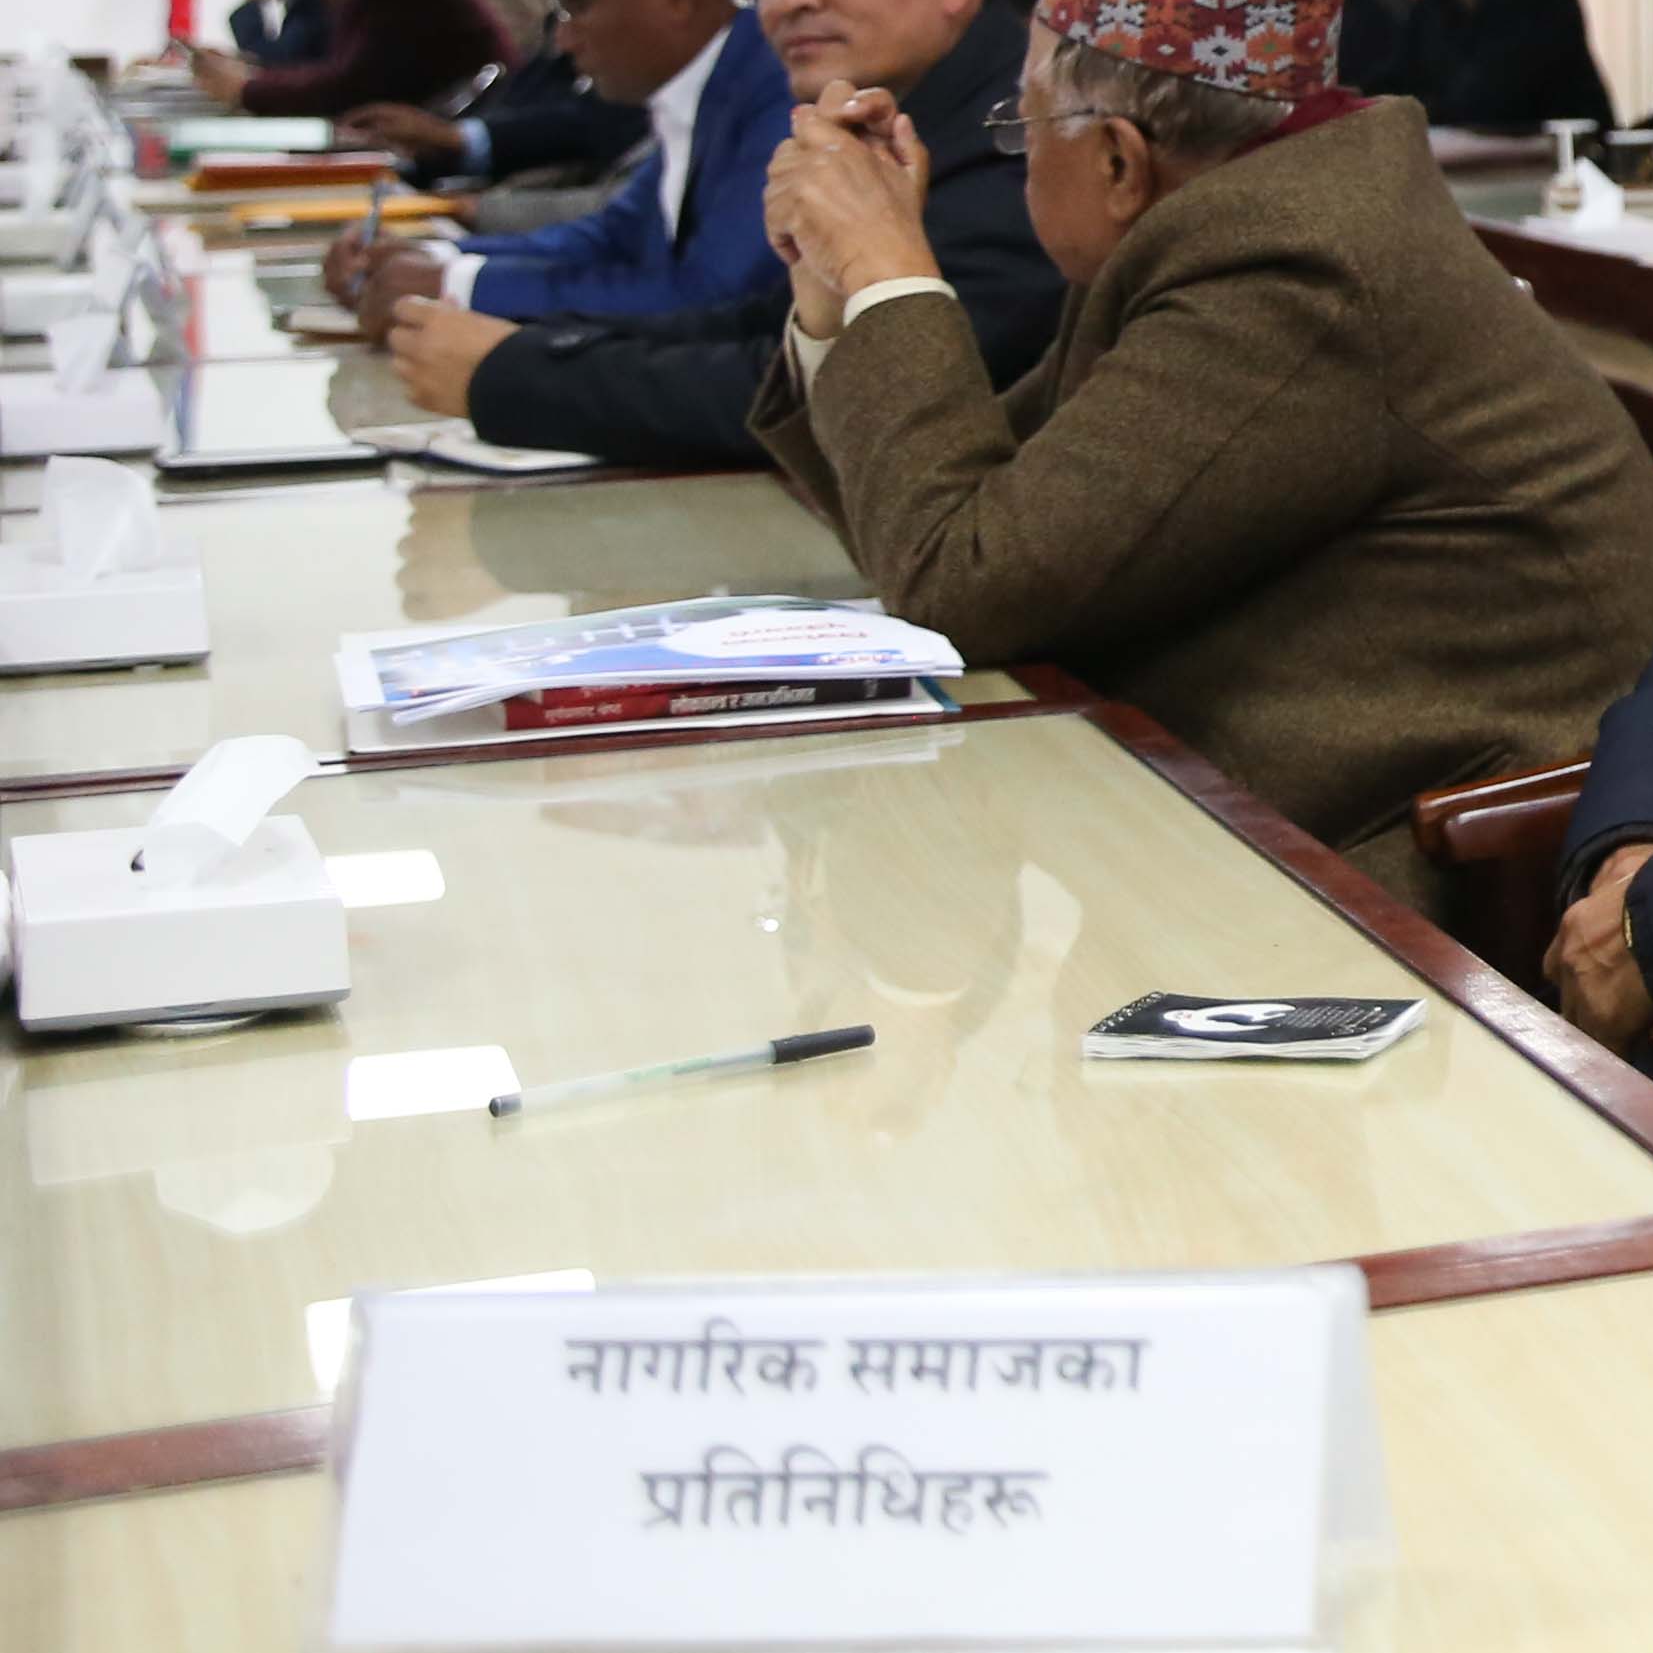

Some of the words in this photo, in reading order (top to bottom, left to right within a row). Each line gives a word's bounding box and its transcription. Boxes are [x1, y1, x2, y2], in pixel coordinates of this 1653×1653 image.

[565, 1316, 824, 1395] नागरिक
[847, 1337, 1149, 1395] समाजका
[639, 1444, 1049, 1533] प्रतिनिधिहरू
